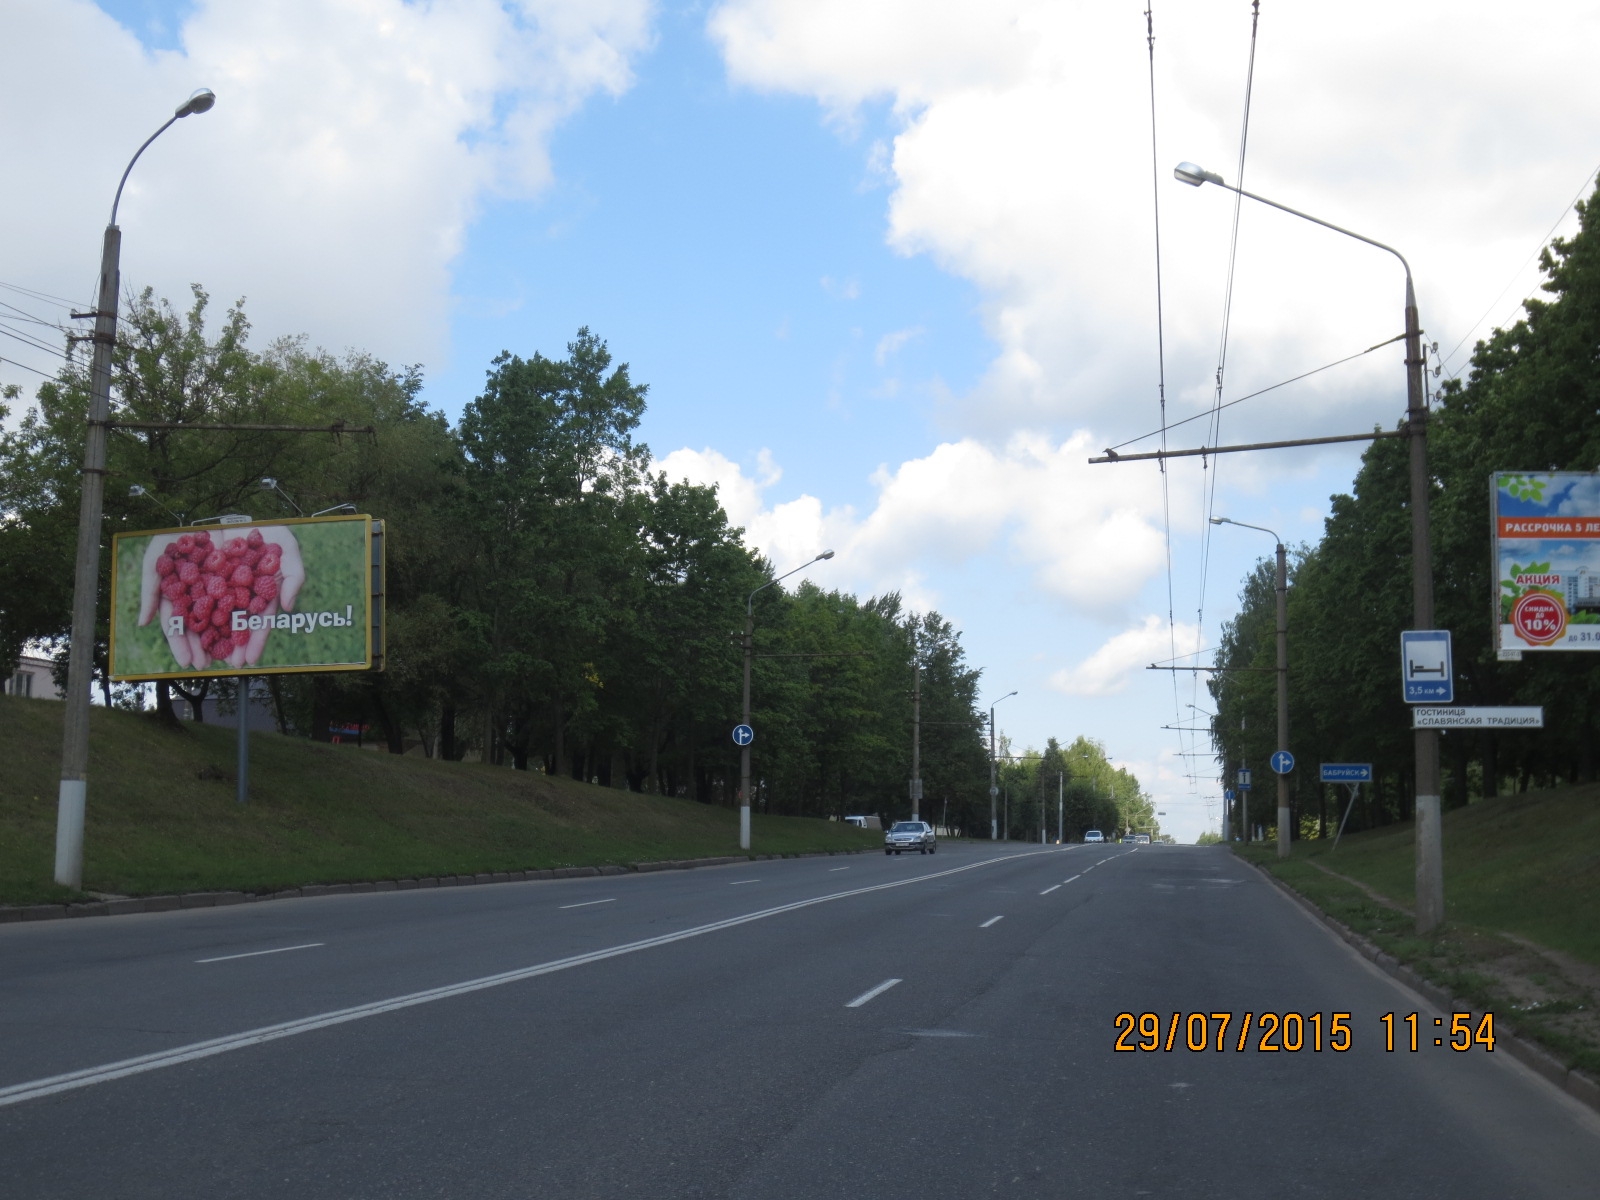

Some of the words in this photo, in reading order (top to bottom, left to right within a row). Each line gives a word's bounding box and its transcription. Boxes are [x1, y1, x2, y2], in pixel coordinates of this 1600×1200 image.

[1505, 523, 1572, 532] РАССРОЧКА
[1575, 523, 1582, 532] 5
[1516, 575, 1560, 585] АКЦИЯ
[168, 615, 184, 636] Я
[231, 605, 353, 634] Беларусь!
[1524, 619, 1556, 631] 10%
[1409, 686, 1423, 696] 3,5
[1416, 708, 1466, 718] гостиница
